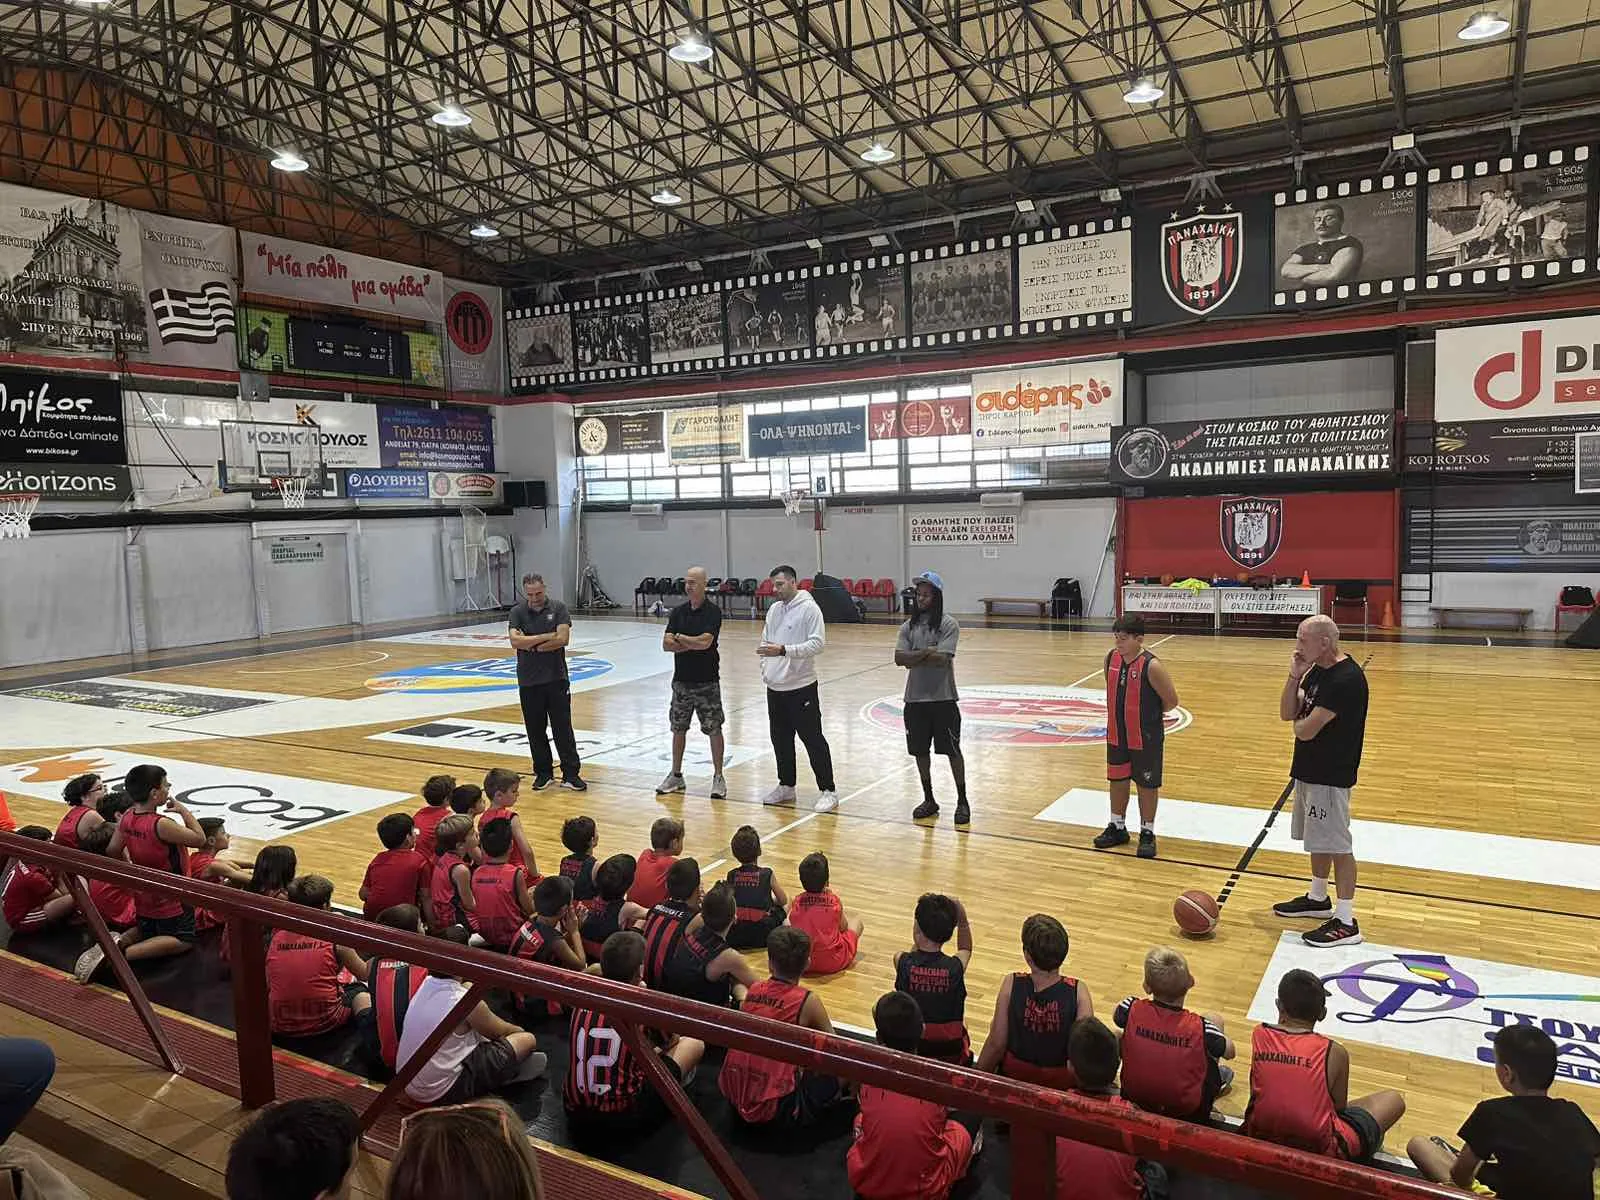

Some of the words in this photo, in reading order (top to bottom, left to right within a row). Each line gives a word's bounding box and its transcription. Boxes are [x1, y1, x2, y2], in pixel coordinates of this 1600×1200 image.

[306, 253, 348, 280] πόλη
[55, 273, 113, 289] ΤΟΦΑΛΟΣ
[1188, 289, 1216, 300] 1891
[1204, 423, 1233, 435] ΣΤΟΝ
[1236, 419, 1279, 432] ΚΟΣΜΟ
[1284, 418, 1307, 430] ΤΟΥ
[1308, 413, 1390, 429] ΑΘΛΗΤΙΣΜΟΥ
[69, 431, 119, 441] Laminate
[1205, 436, 1227, 448] ΤΗΣ
[1228, 433, 1282, 447] ΠΑΙΔΕΙΑΣ
[1286, 432, 1309, 443] ΤΟΥ
[1310, 427, 1389, 443] ΠΟΛΙΤΙΣΜΟΥ
[1170, 459, 1267, 477] ΑΚΑΔΗΜΙΕΣ
[1274, 452, 1391, 473] ΠΑΝΑΧΑΪΚΗΣ
[362, 474, 425, 487] ΔΟΥΒΡΗΣ
[920, 517, 960, 526] ΑΘΛΗΤΗΣ
[964, 517, 981, 525] ΠΟΥ
[984, 515, 1014, 524] ΠΑΙΖΕΙ
[911, 526, 949, 534] ΑΤΟΜΙΚΑ
[951, 525, 968, 533] ΔΕΝ
[924, 533, 969, 542] ΟΜΑΔΙΚΟ
[972, 532, 1015, 541] ΑΘΛΗΜΑ
[576, 1026, 622, 1095] 12
